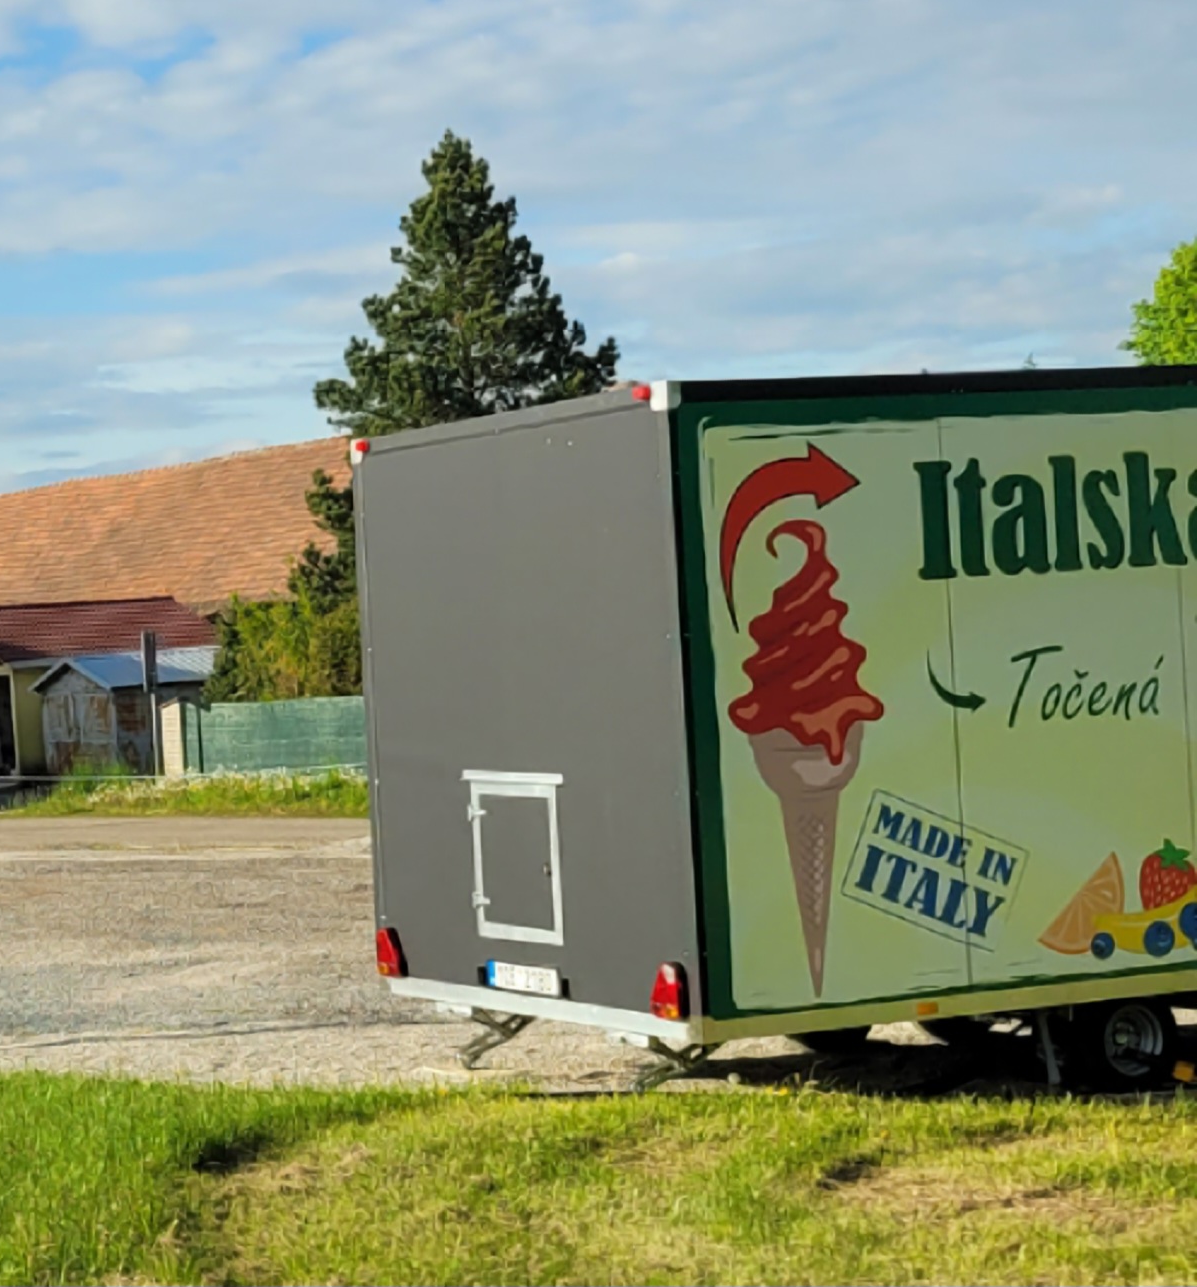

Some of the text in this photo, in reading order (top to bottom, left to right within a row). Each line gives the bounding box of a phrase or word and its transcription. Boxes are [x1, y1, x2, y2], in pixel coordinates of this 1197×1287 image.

[912, 450, 1197, 581] Italsk
[1008, 645, 1164, 728] Točená
[872, 802, 1018, 887] MADE IN
[854, 843, 1006, 938] ITALY
